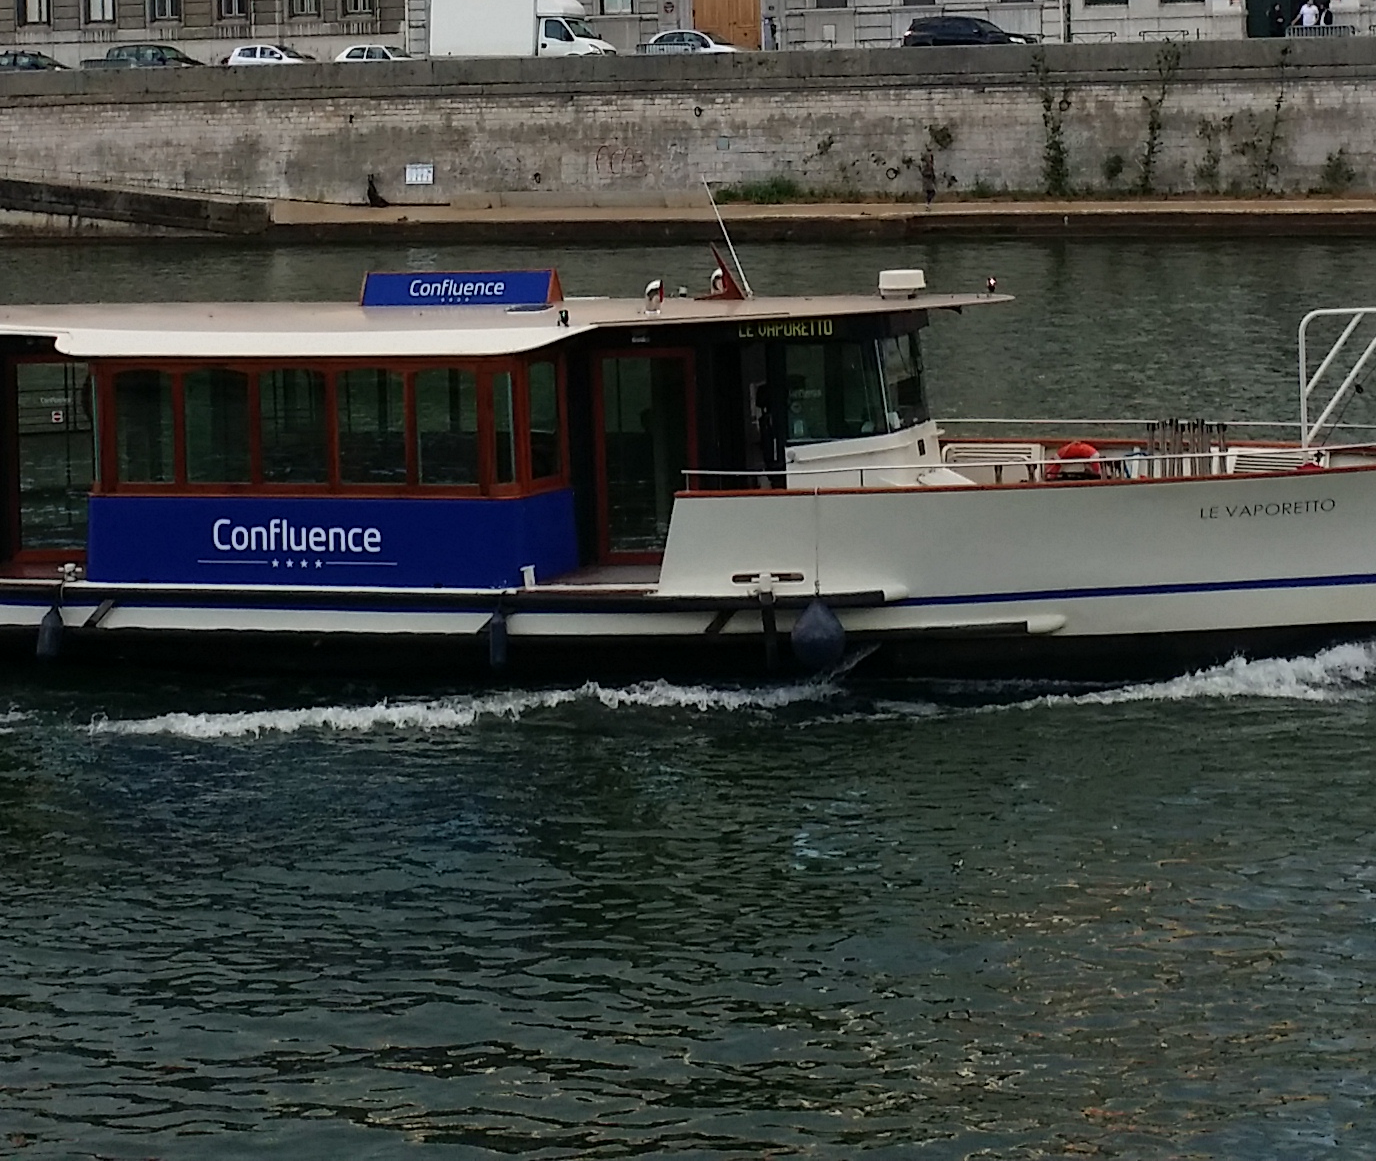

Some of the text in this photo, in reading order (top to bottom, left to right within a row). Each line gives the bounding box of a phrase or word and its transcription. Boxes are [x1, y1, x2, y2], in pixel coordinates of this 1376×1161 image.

[409, 279, 505, 297] Confluence
[738, 319, 833, 338] LE VAPORETTO
[1200, 498, 1336, 520] LE VAPORETTO
[213, 518, 382, 553] Confluence
